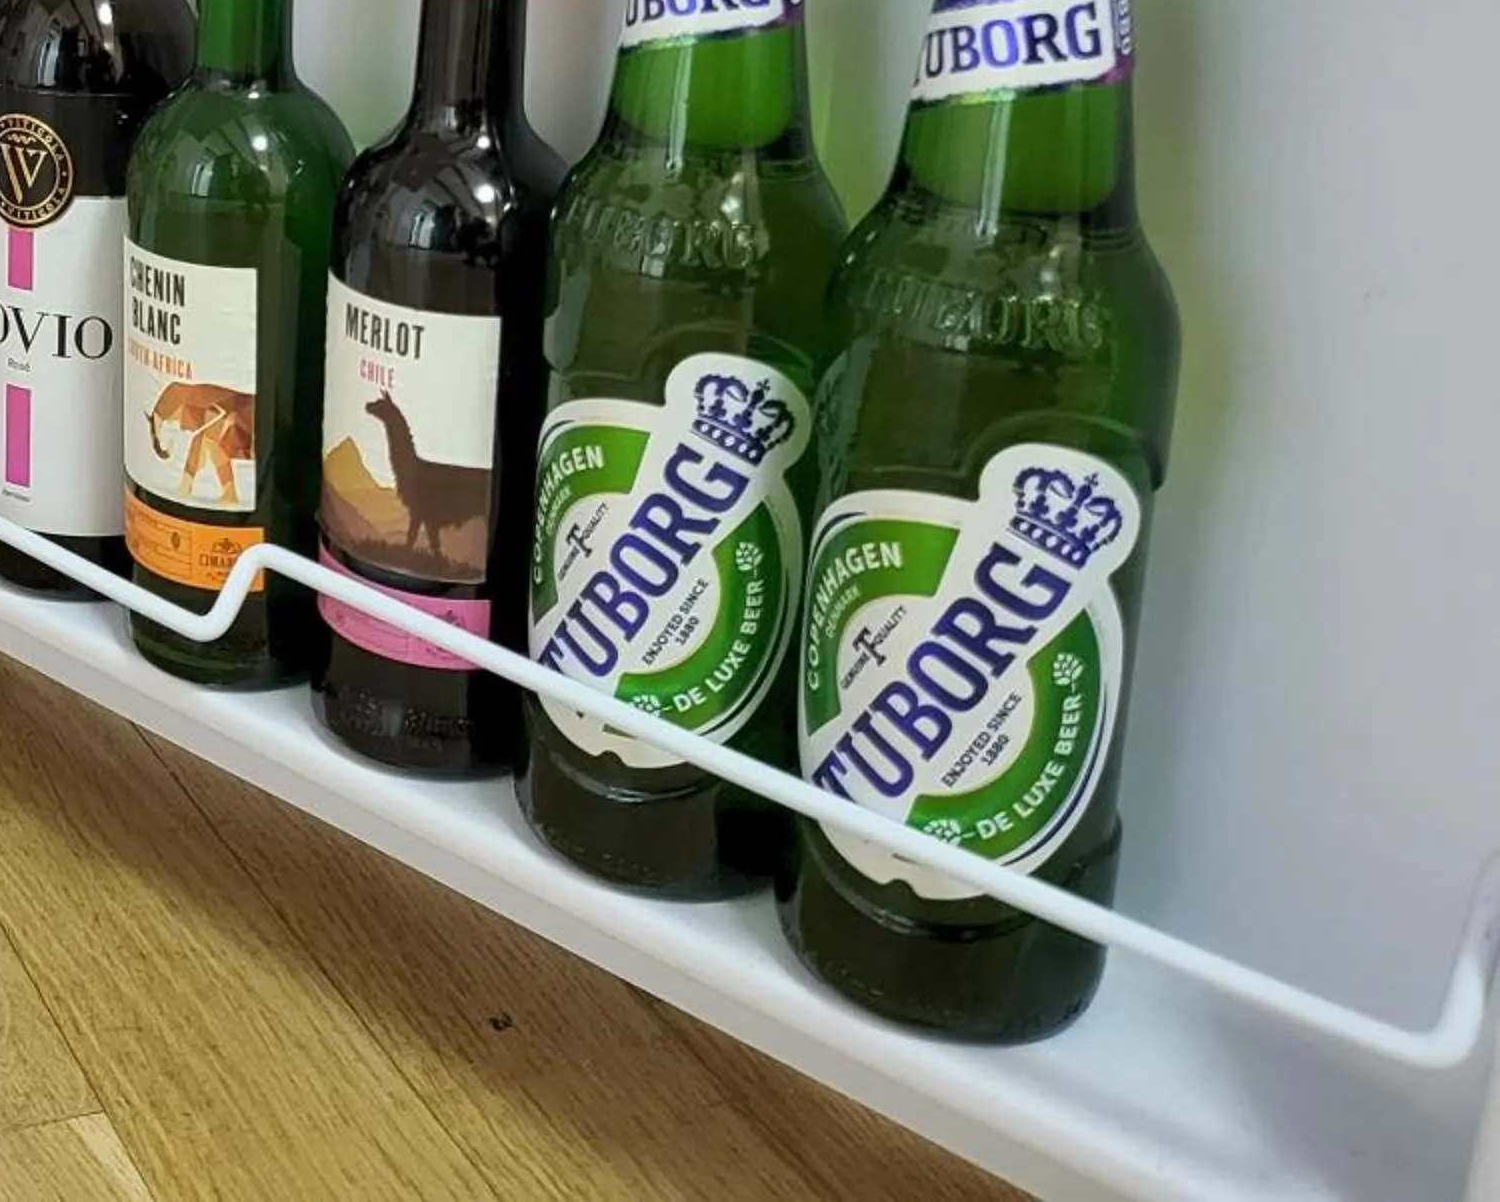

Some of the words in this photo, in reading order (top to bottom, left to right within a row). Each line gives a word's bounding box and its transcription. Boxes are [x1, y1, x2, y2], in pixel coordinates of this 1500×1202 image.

[920, 0, 1103, 79] UBORG
[130, 255, 185, 308] CHENIN
[132, 295, 181, 346] BLANC
[345, 301, 426, 361] MERLOT
[358, 358, 396, 390] CHILE
[533, 444, 605, 584] COPENHAGEN
[537, 441, 751, 679] TUBORG
[641, 613, 684, 666] ENJOYED
[679, 577, 709, 616] SINCE
[672, 686, 708, 714] DE
[704, 639, 751, 694] LUXE
[739, 578, 765, 636] BEER
[675, 615, 700, 646] 1880
[807, 541, 904, 691] COPENHAGEN
[873, 604, 909, 648] QUALITY
[811, 541, 1075, 802] TUBORG
[941, 730, 992, 789] ENJOYED
[986, 691, 1023, 734] SINCE
[975, 810, 1015, 840] DE
[1012, 758, 1067, 819] LUXE
[1053, 693, 1083, 757] BEER
[980, 733, 1010, 767] 1880
